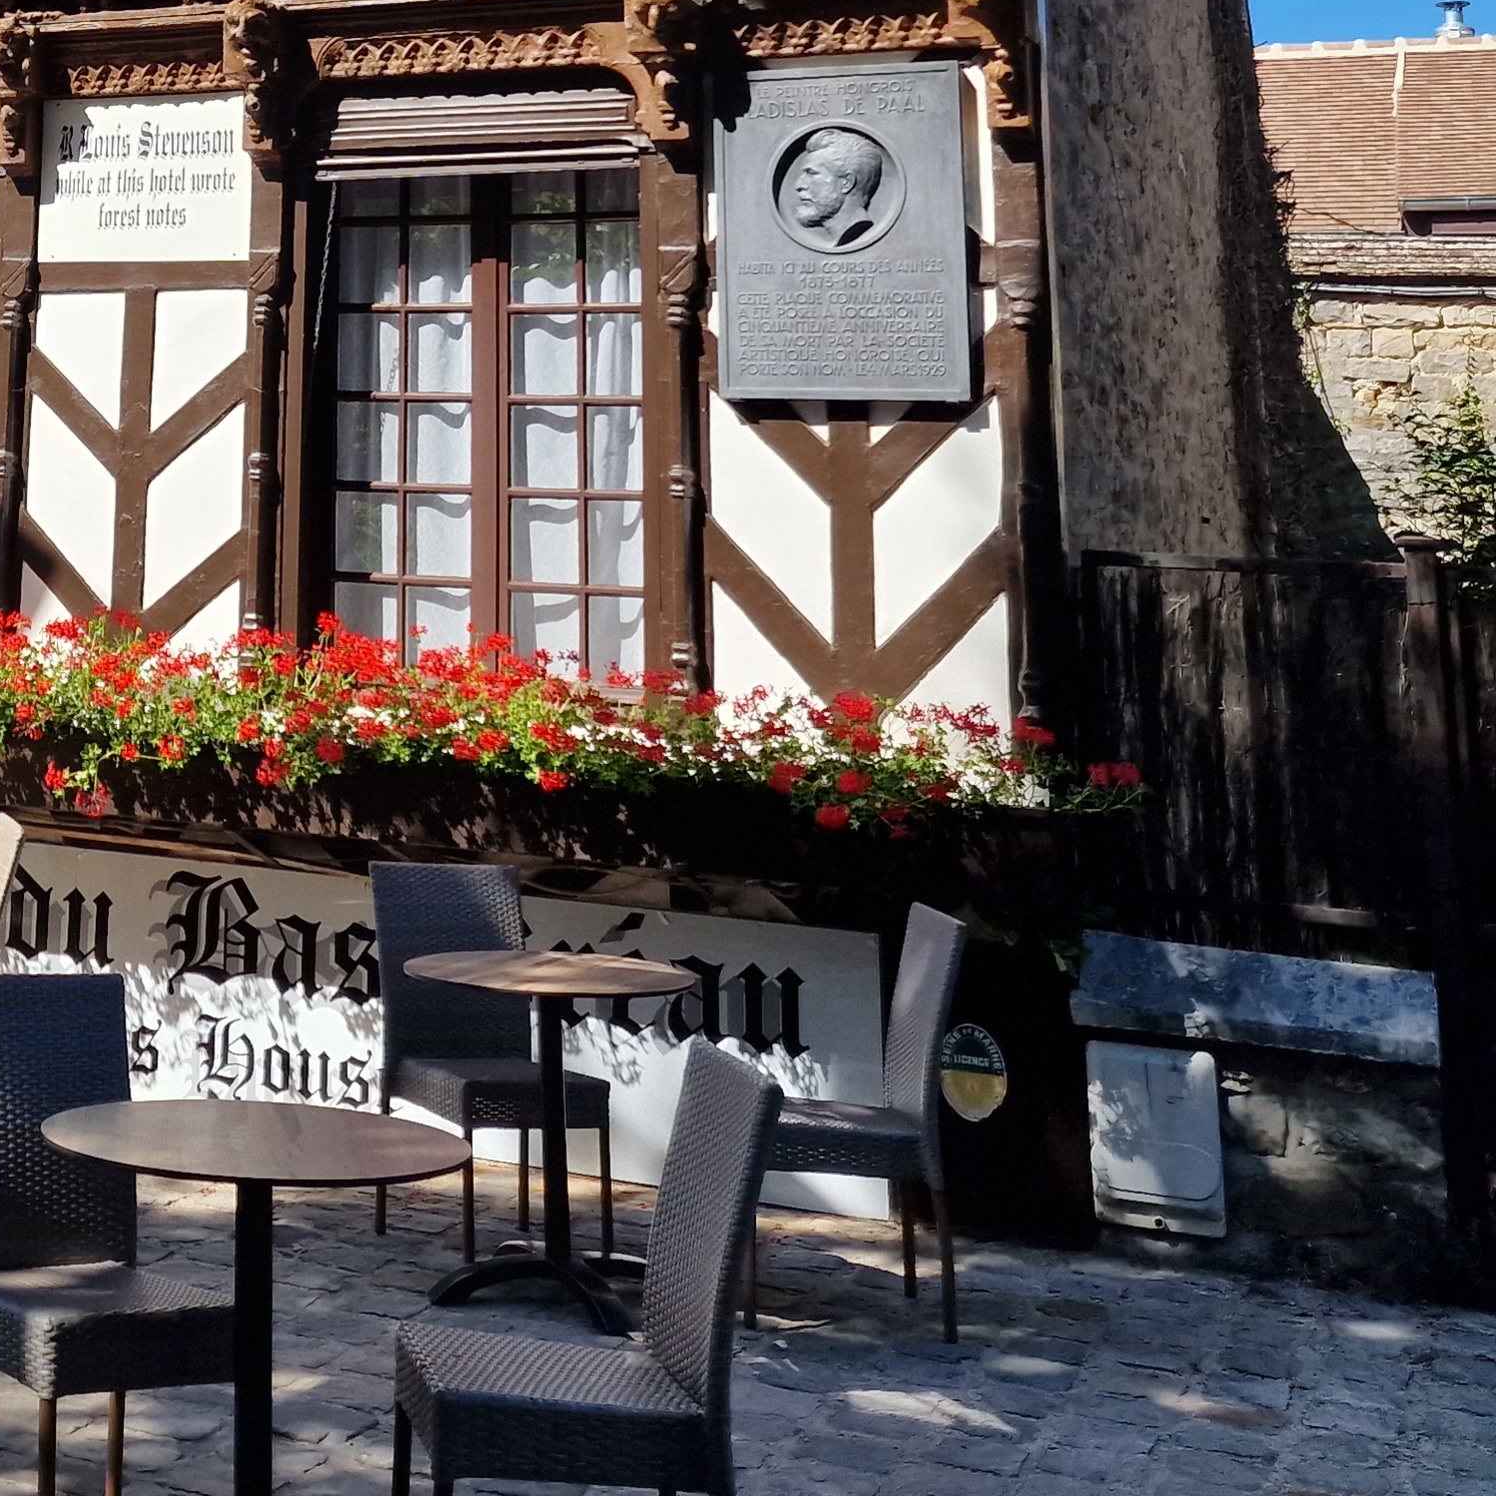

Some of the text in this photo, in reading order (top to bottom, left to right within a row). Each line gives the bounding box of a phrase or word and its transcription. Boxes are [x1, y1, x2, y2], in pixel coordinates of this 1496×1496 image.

[757, 79, 914, 99] LE PEINTRE HONGROIS
[747, 99, 829, 119] LADISLAS
[844, 97, 867, 116] DE
[79, 123, 130, 162] Louis
[137, 120, 234, 160] Stevenson
[55, 167, 236, 201] while at this hotel wrote
[97, 202, 186, 229] forest notes
[822, 260, 865, 274] COURS
[869, 260, 891, 274] DES
[774, 292, 823, 306] PLAQUE
[926, 306, 944, 319] DU
[5, 863, 114, 966] du
[166, 870, 382, 1005] Bas
[195, 1014, 403, 1113] Hous
